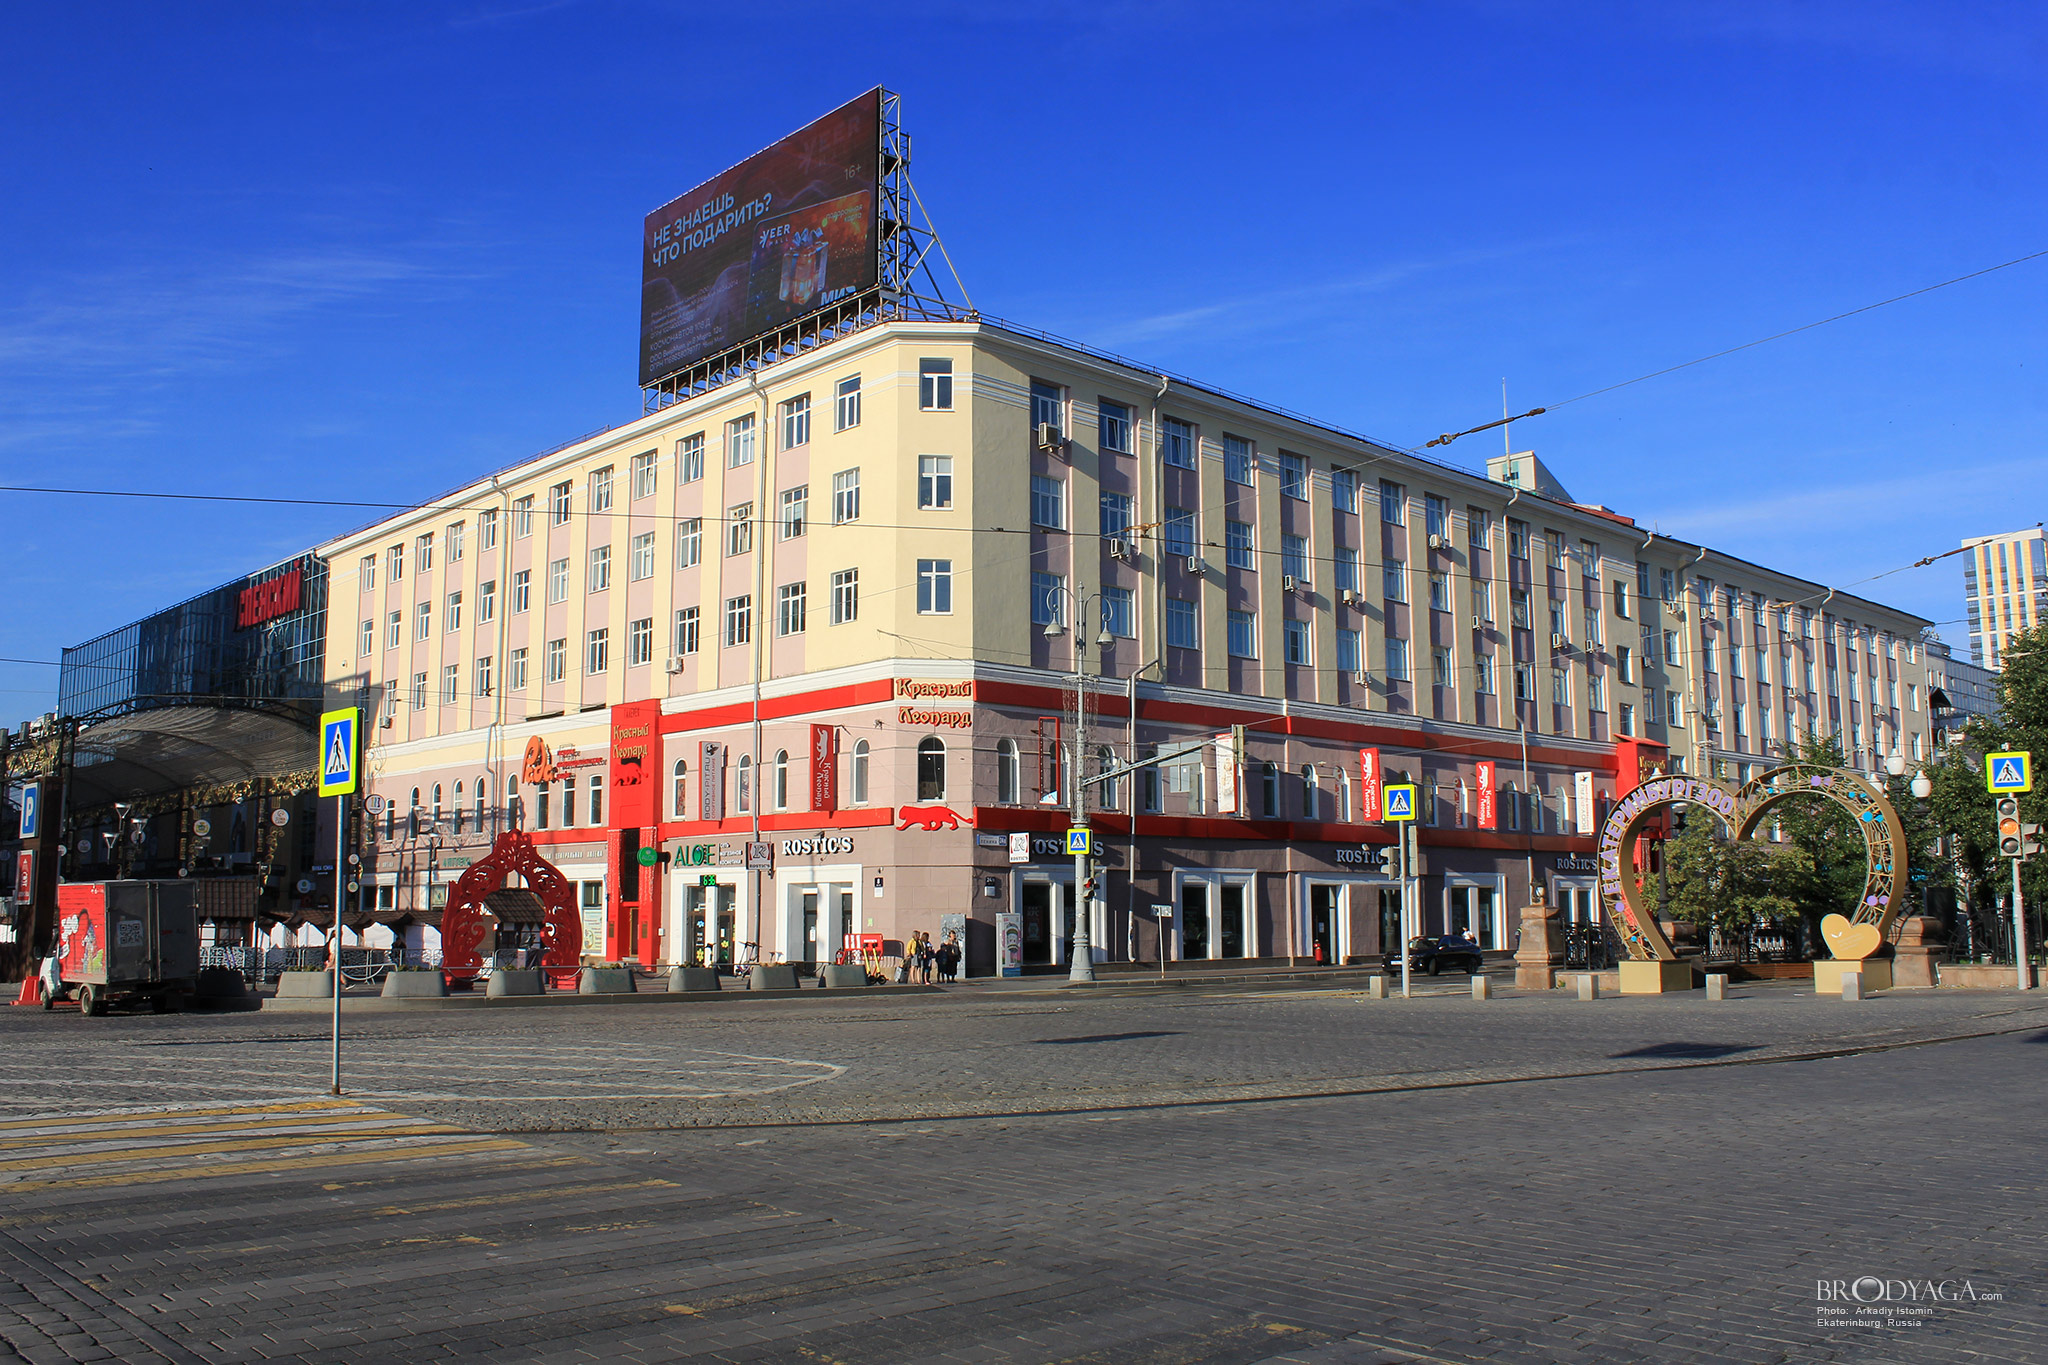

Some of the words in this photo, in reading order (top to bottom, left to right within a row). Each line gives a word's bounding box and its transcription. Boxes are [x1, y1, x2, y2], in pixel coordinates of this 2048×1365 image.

[844, 164, 862, 181] 16+
[653, 224, 671, 248] НЕ
[674, 192, 735, 237] ЗНАЕШЬ
[653, 242, 680, 268] ЧТО
[683, 192, 773, 254] ПОДАРИТЬ?
[896, 678, 971, 699] Красный
[898, 706, 972, 728] Леопард
[613, 723, 649, 743] Красный
[613, 744, 648, 759] Леопард
[674, 844, 716, 866] ALOE
[782, 837, 853, 855] ROSTIC'S
